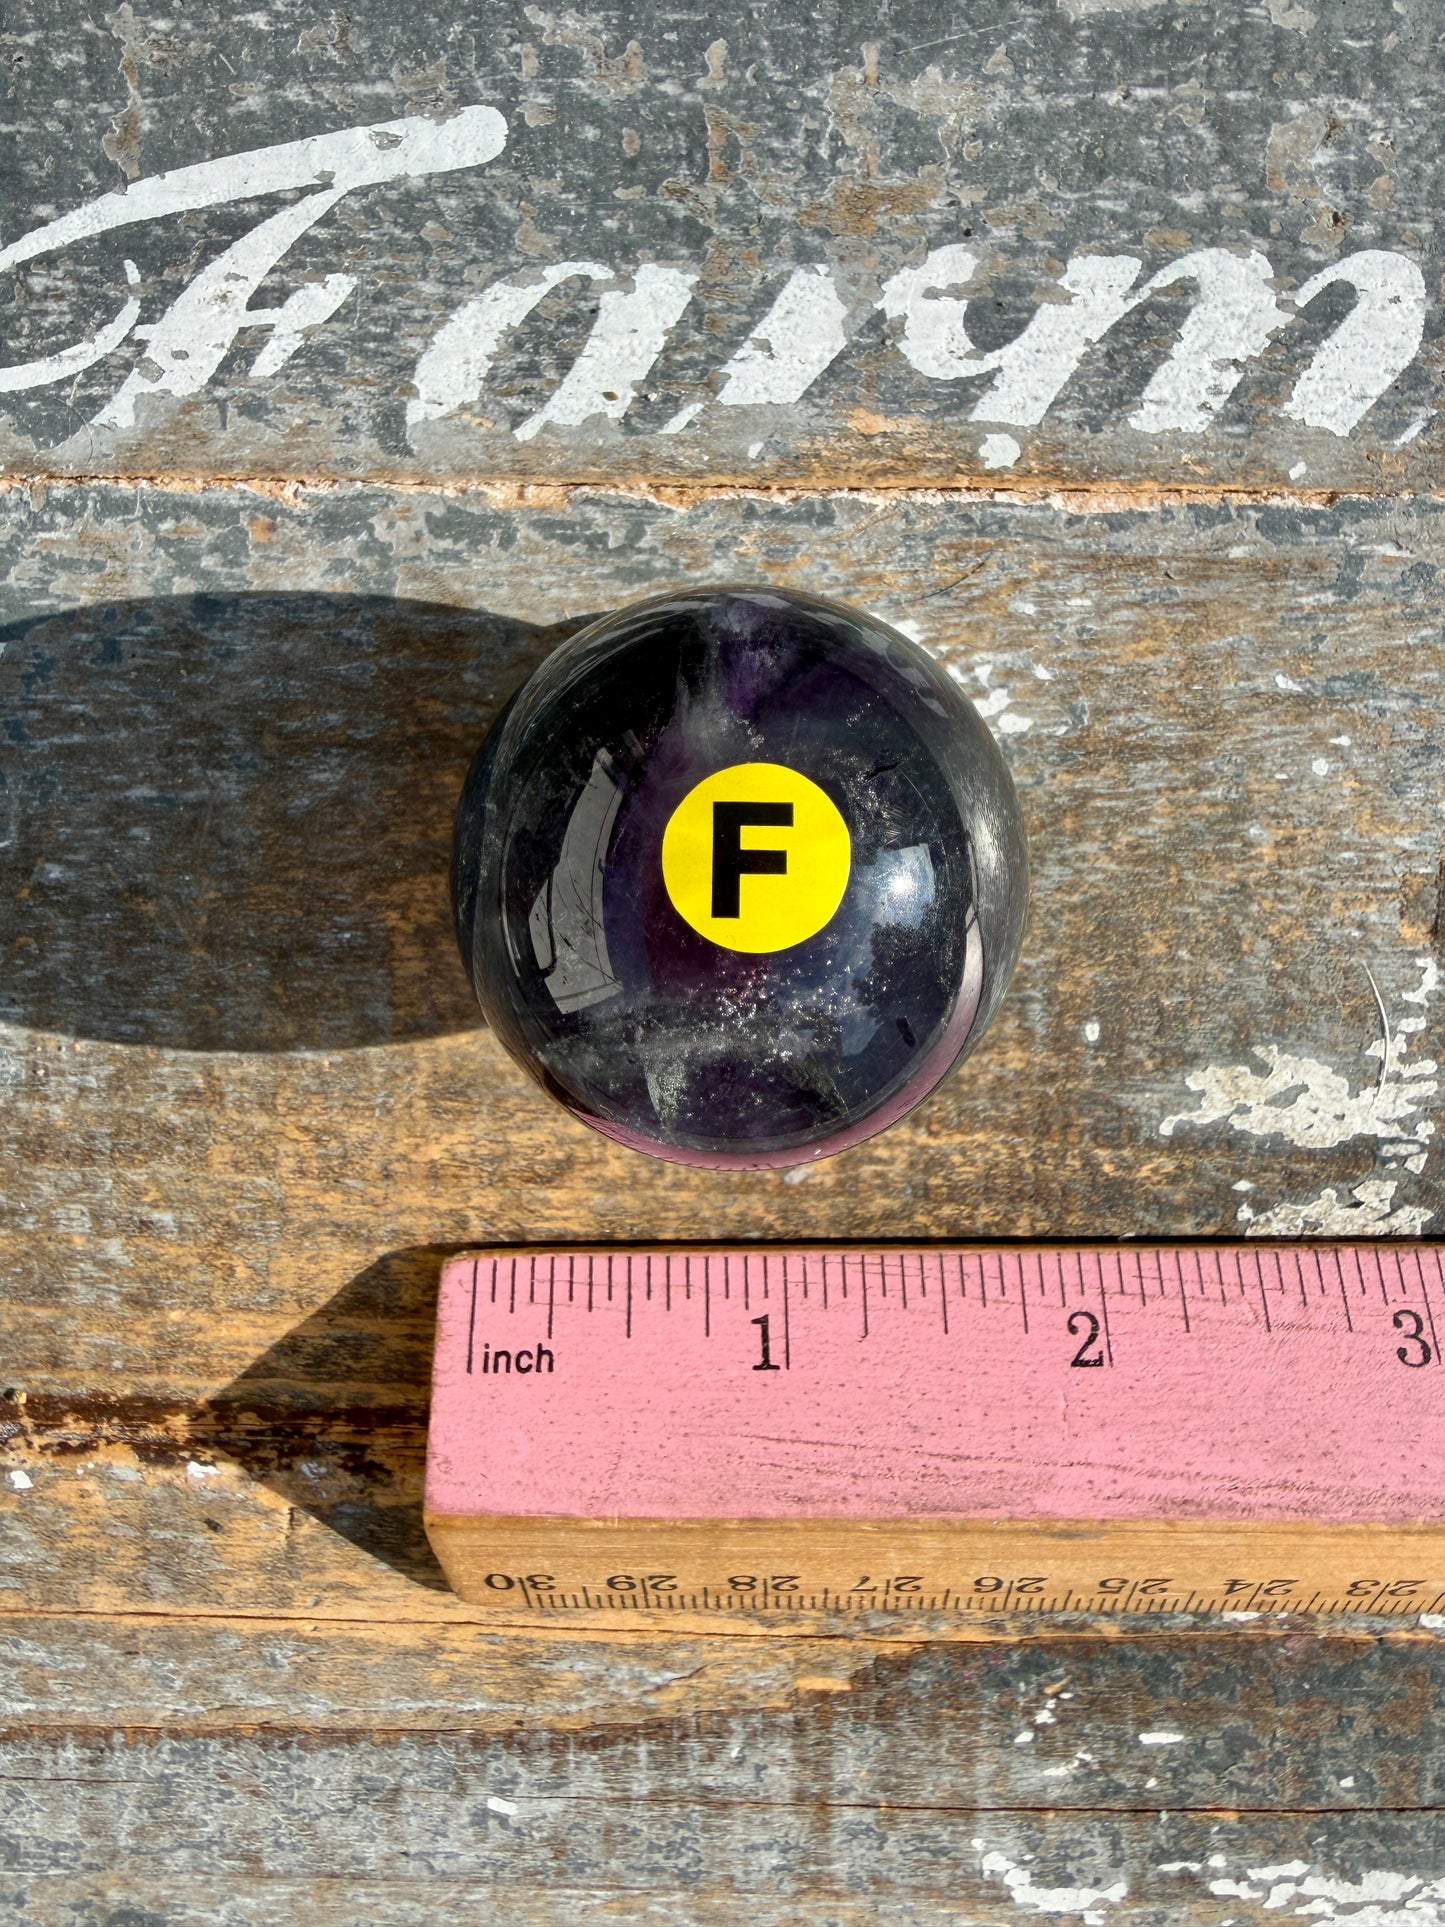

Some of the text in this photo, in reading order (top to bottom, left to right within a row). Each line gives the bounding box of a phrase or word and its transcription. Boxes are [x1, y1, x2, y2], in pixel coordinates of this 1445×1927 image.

[710, 801, 794, 919] F
[482, 1309, 1433, 1374] inch 1 2 3
[484, 1572, 1428, 1597] 23 24 25 26 27 28 29 30
